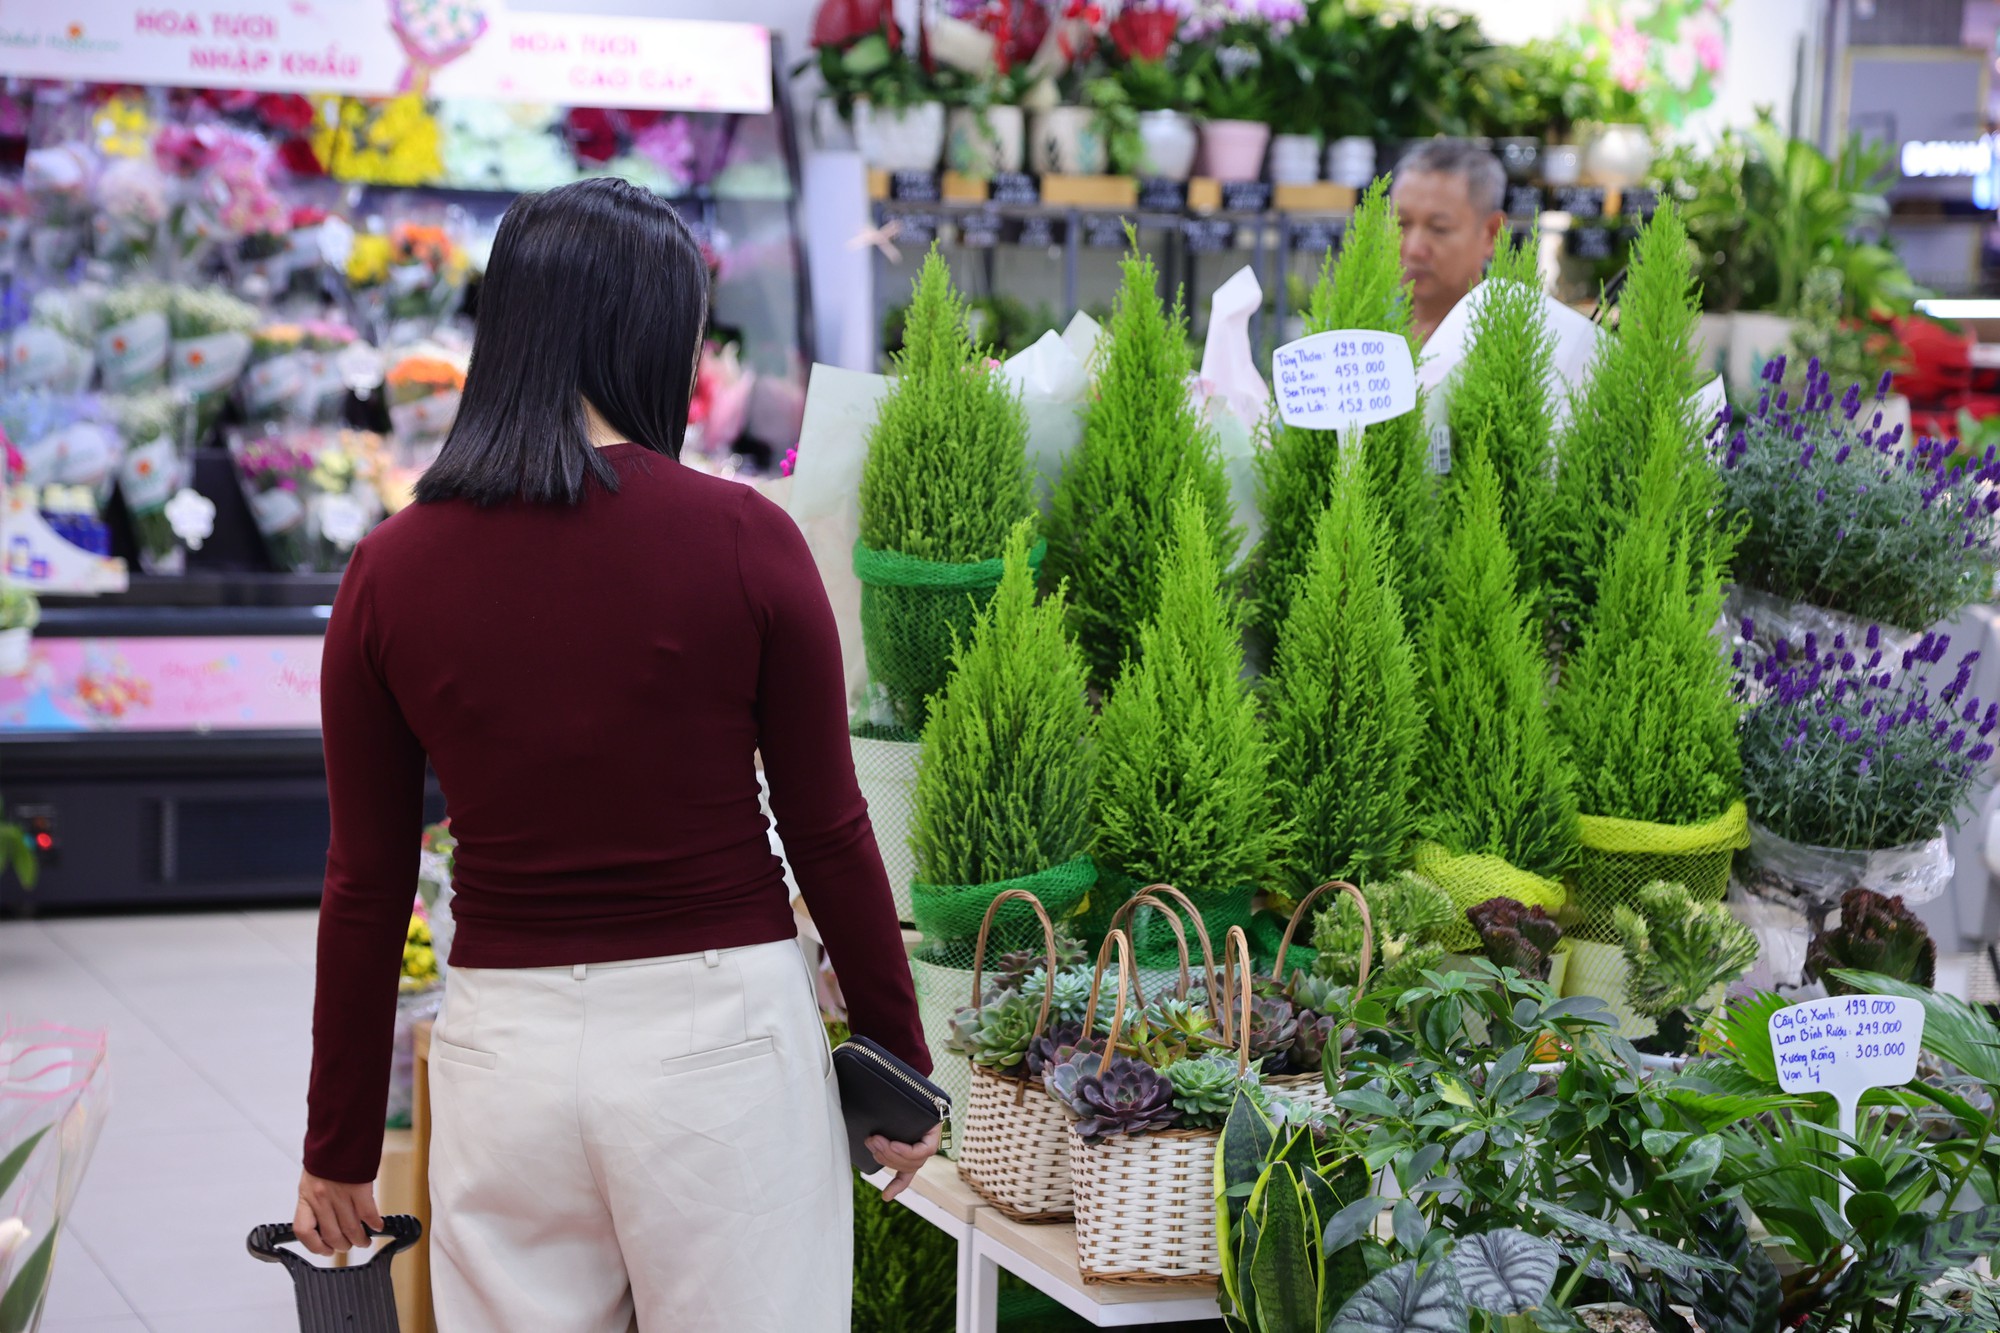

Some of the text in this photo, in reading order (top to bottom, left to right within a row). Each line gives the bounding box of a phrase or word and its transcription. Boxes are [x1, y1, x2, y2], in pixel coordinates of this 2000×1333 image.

[135, 9, 200, 36] HOA
[1773, 1013, 1794, 1029] Cây
[1844, 999, 1896, 1015] 199.000
[1776, 1034, 1796, 1045] Lan
[1855, 1041, 1906, 1059] 309.000
[1808, 1064, 1820, 1084] Lý
